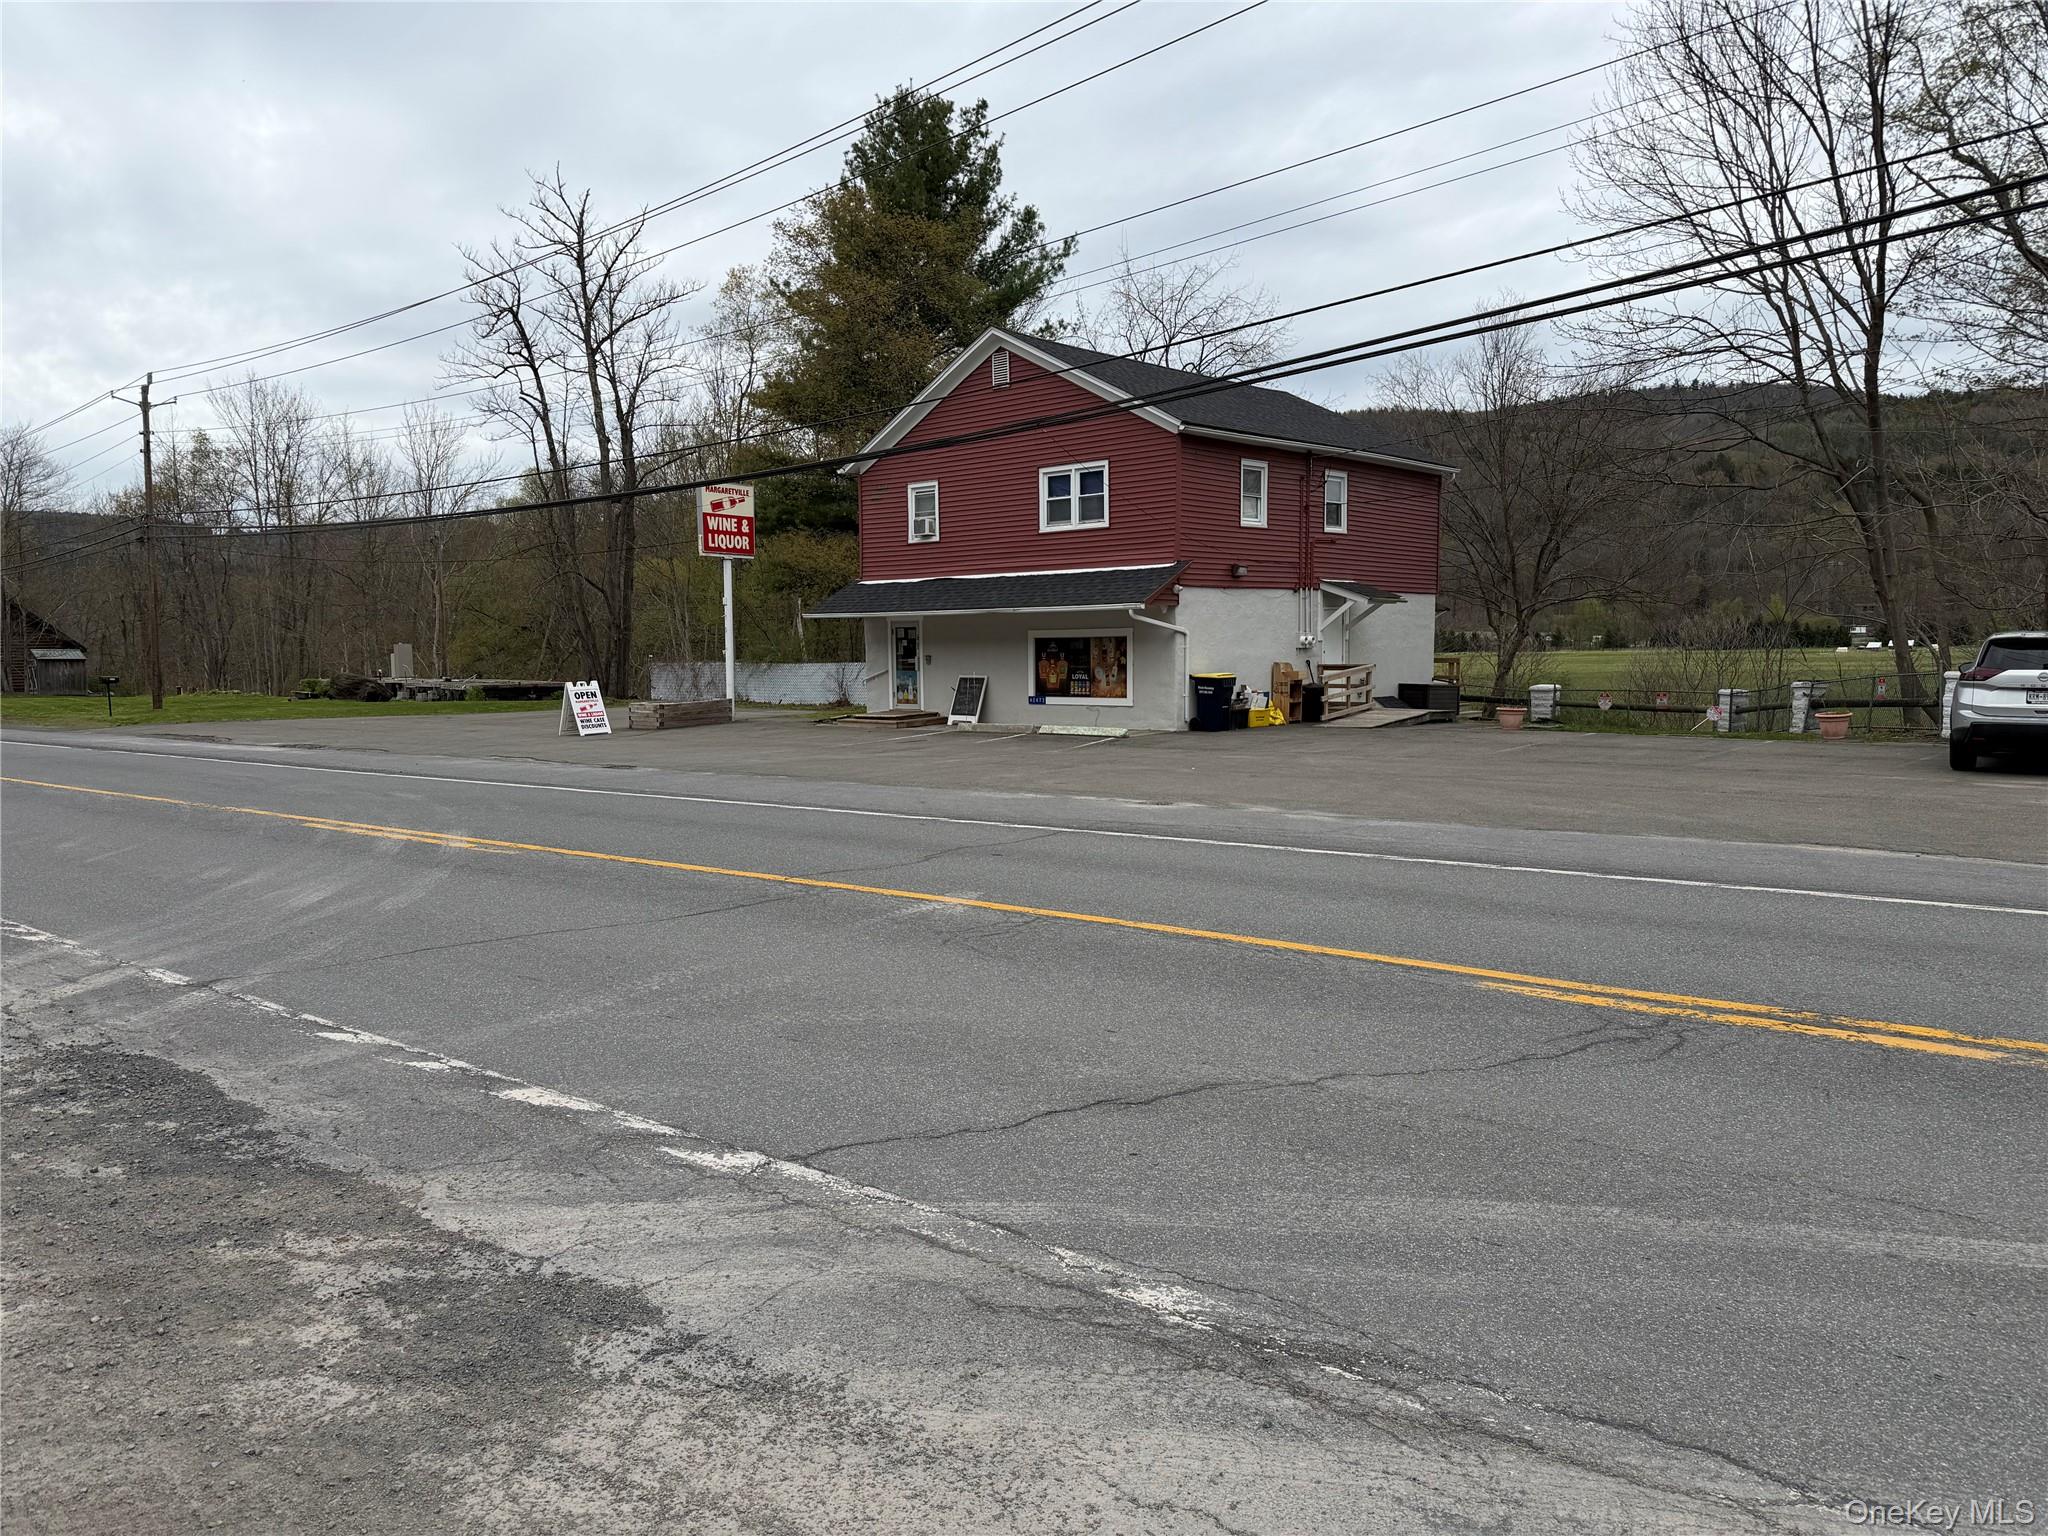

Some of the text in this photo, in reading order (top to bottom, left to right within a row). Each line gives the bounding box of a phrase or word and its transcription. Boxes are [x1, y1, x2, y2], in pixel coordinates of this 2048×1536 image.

[705, 486, 749, 496] MARGARETVILLE
[707, 516, 750, 533] WINE &
[708, 533, 750, 549] LIQUOR
[574, 691, 598, 700] OPEN
